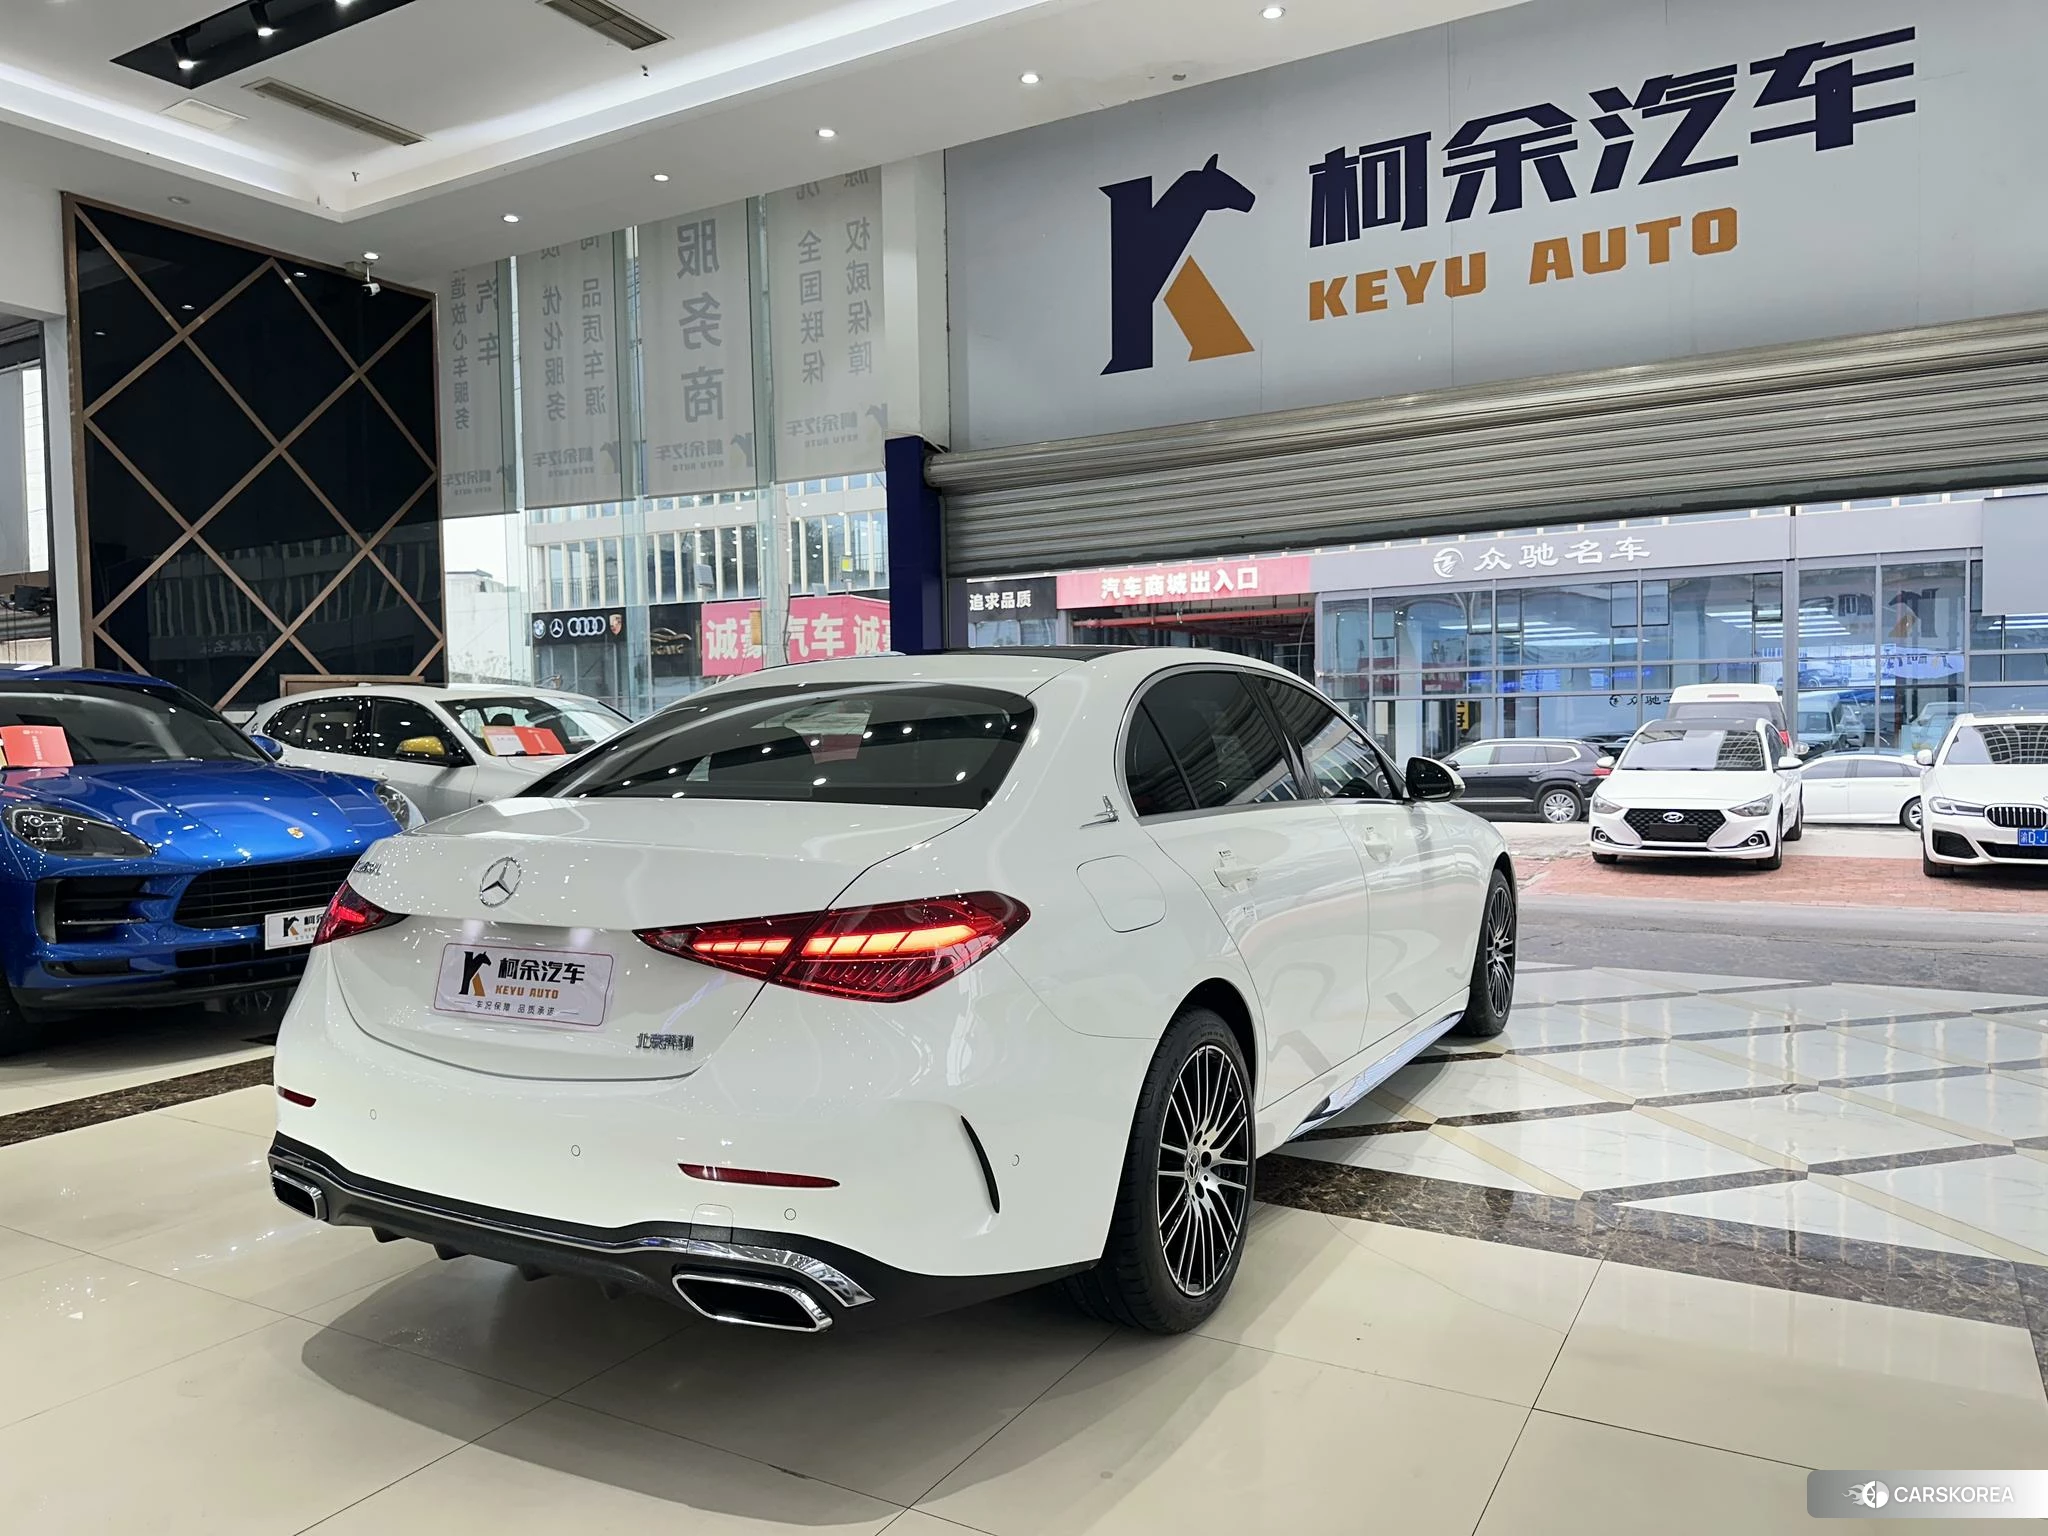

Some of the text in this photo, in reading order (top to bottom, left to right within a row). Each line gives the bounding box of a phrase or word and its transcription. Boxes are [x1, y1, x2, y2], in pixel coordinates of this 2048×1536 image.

[1308, 27, 1915, 248] 柯余汽车
[1309, 207, 1738, 321] KEYU AUTO
[1473, 536, 1652, 573] 众驰名车
[1101, 566, 1259, 599] 汽车商城出入口
[968, 590, 1032, 612] 追求品质
[498, 957, 585, 984] 柯余汽车
[495, 985, 559, 999] KEYU AUTO
